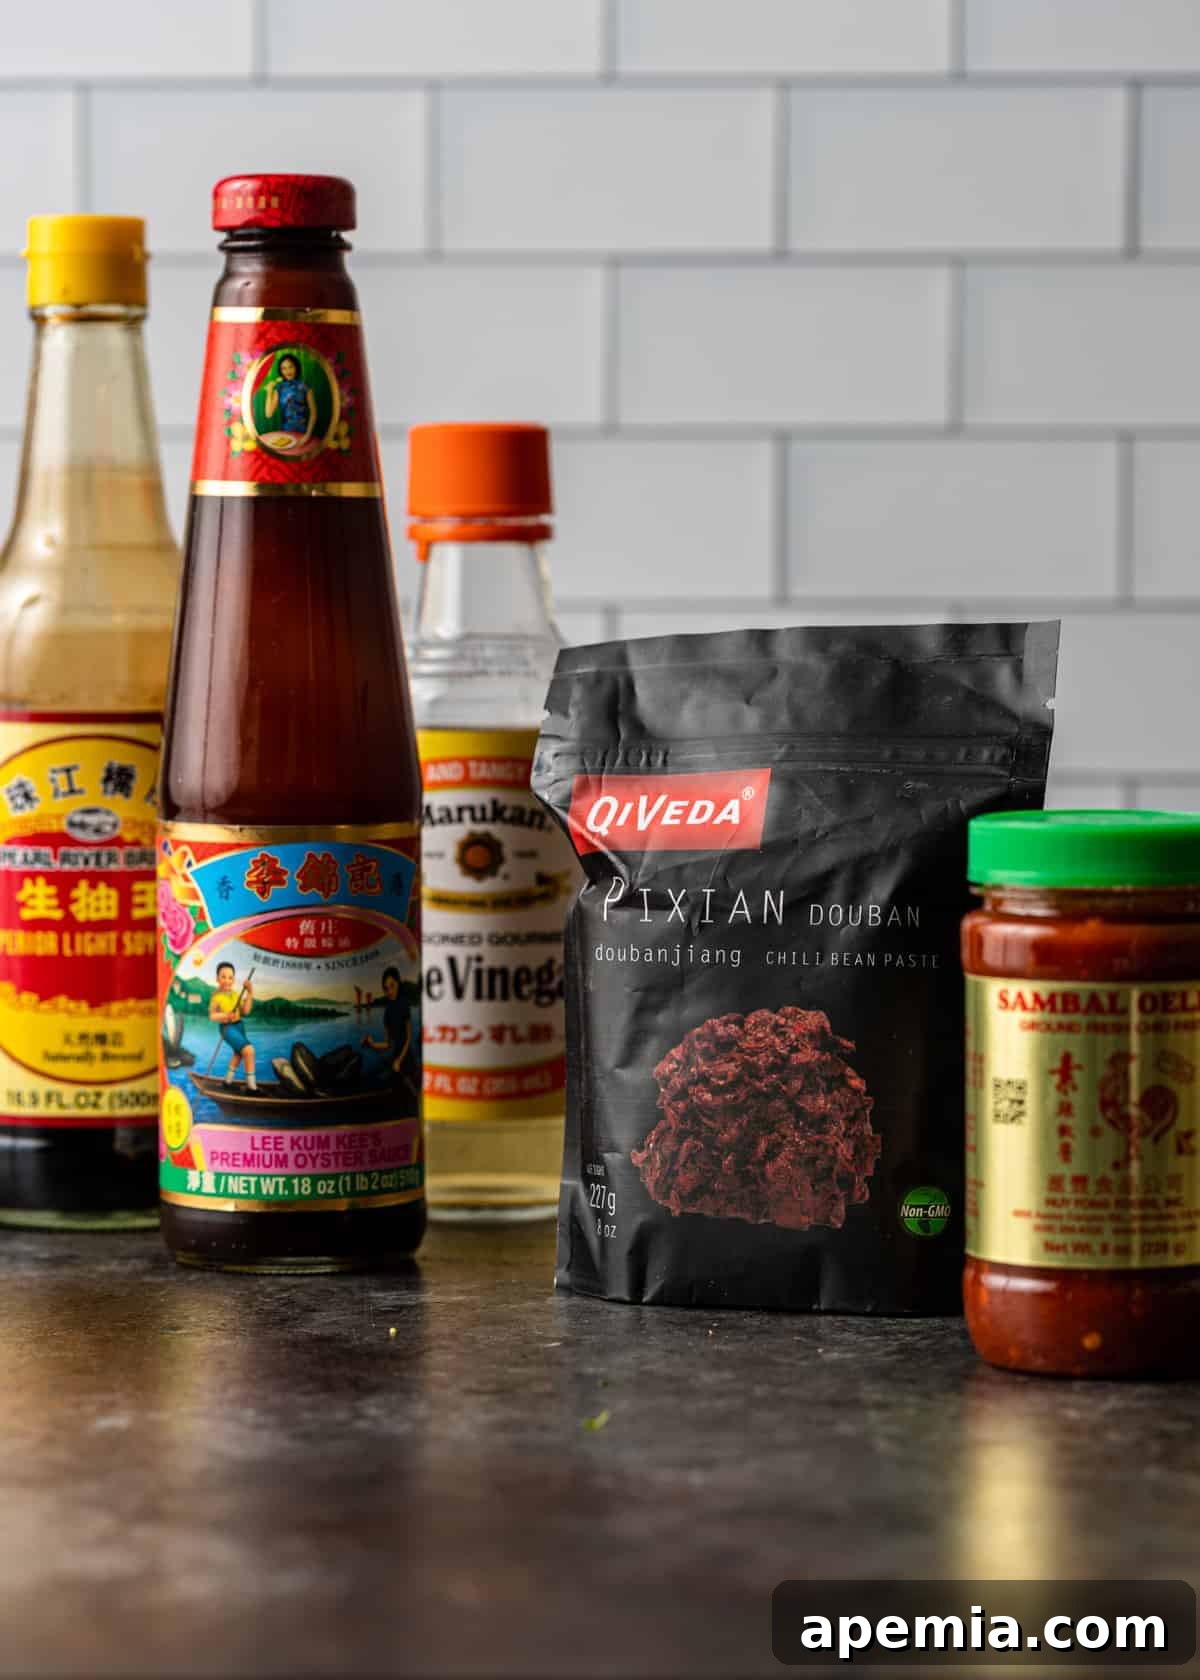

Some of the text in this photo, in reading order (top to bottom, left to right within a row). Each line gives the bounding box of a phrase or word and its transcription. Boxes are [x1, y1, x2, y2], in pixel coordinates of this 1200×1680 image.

[602, 876, 921, 929] PIXIAN DOUBAN
[594, 944, 941, 969] doubanjiang CHILI BEAN PASTE
[997, 989, 1127, 1015] SAMBAL
[250, 1131, 383, 1151] LEE KUM KEE'S
[210, 1152, 288, 1169] PREMIUM
[294, 1148, 363, 1169] OYSTER
[227, 1176, 257, 1195] NET
[259, 1178, 288, 1196] WT.
[291, 1178, 312, 1195] 18
[316, 1182, 336, 1195] oz
[355, 1174, 368, 1190] lb
[370, 1174, 379, 1190] 2
[900, 1204, 951, 1218] Non-GMO
